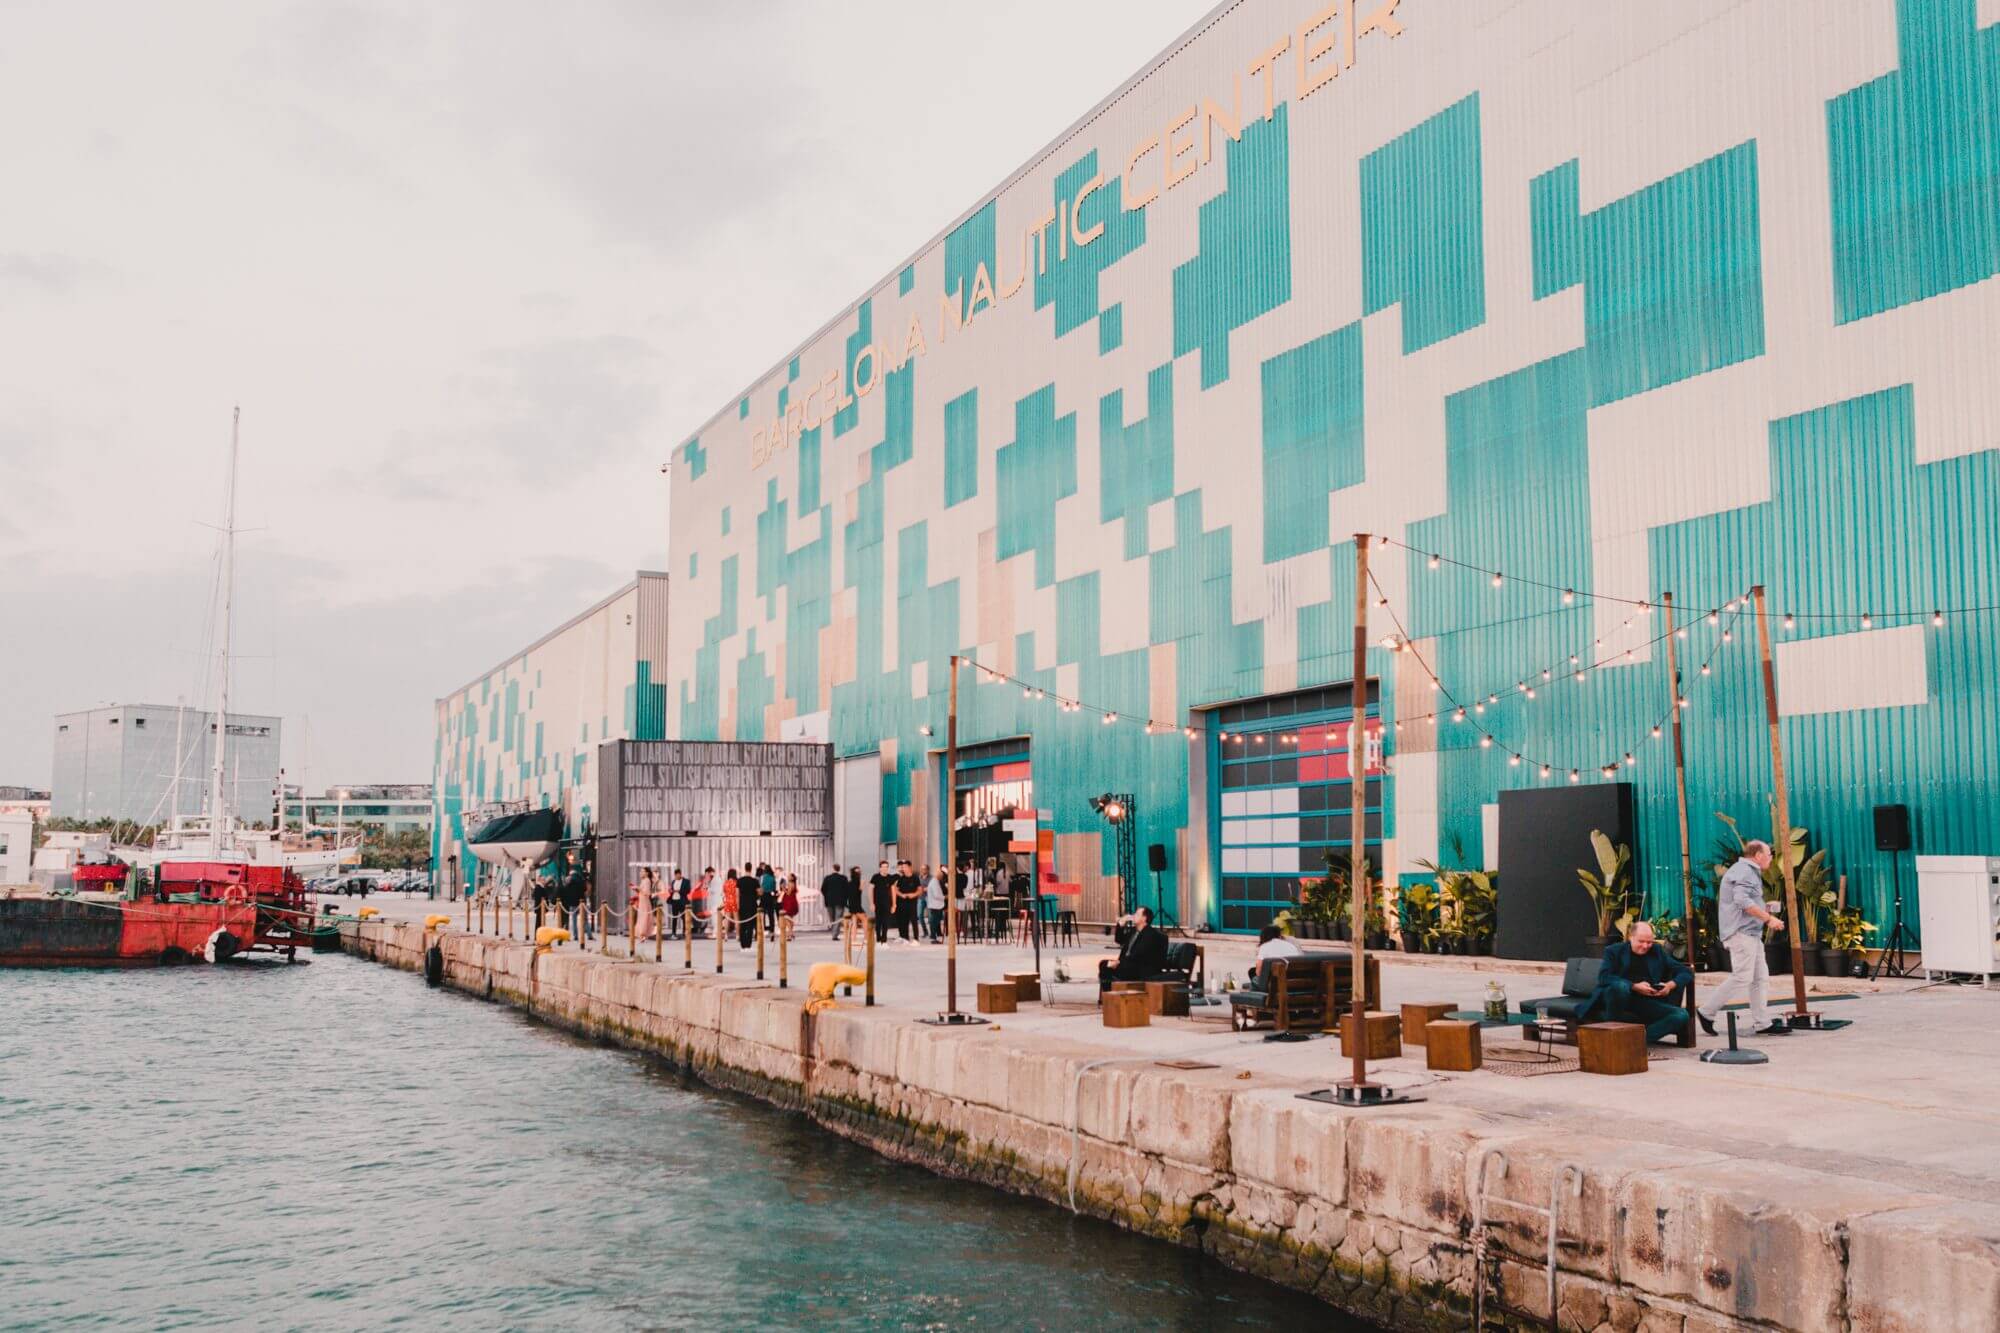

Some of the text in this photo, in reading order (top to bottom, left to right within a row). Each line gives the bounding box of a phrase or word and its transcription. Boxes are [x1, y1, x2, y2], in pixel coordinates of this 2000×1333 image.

[751, 0, 1407, 471] BARCELONA NAUTIC CENTER
[641, 742, 680, 763] DARING
[657, 765, 701, 787] STYLISH
[703, 766, 759, 788] CONFIDENT
[761, 767, 799, 788] DARING
